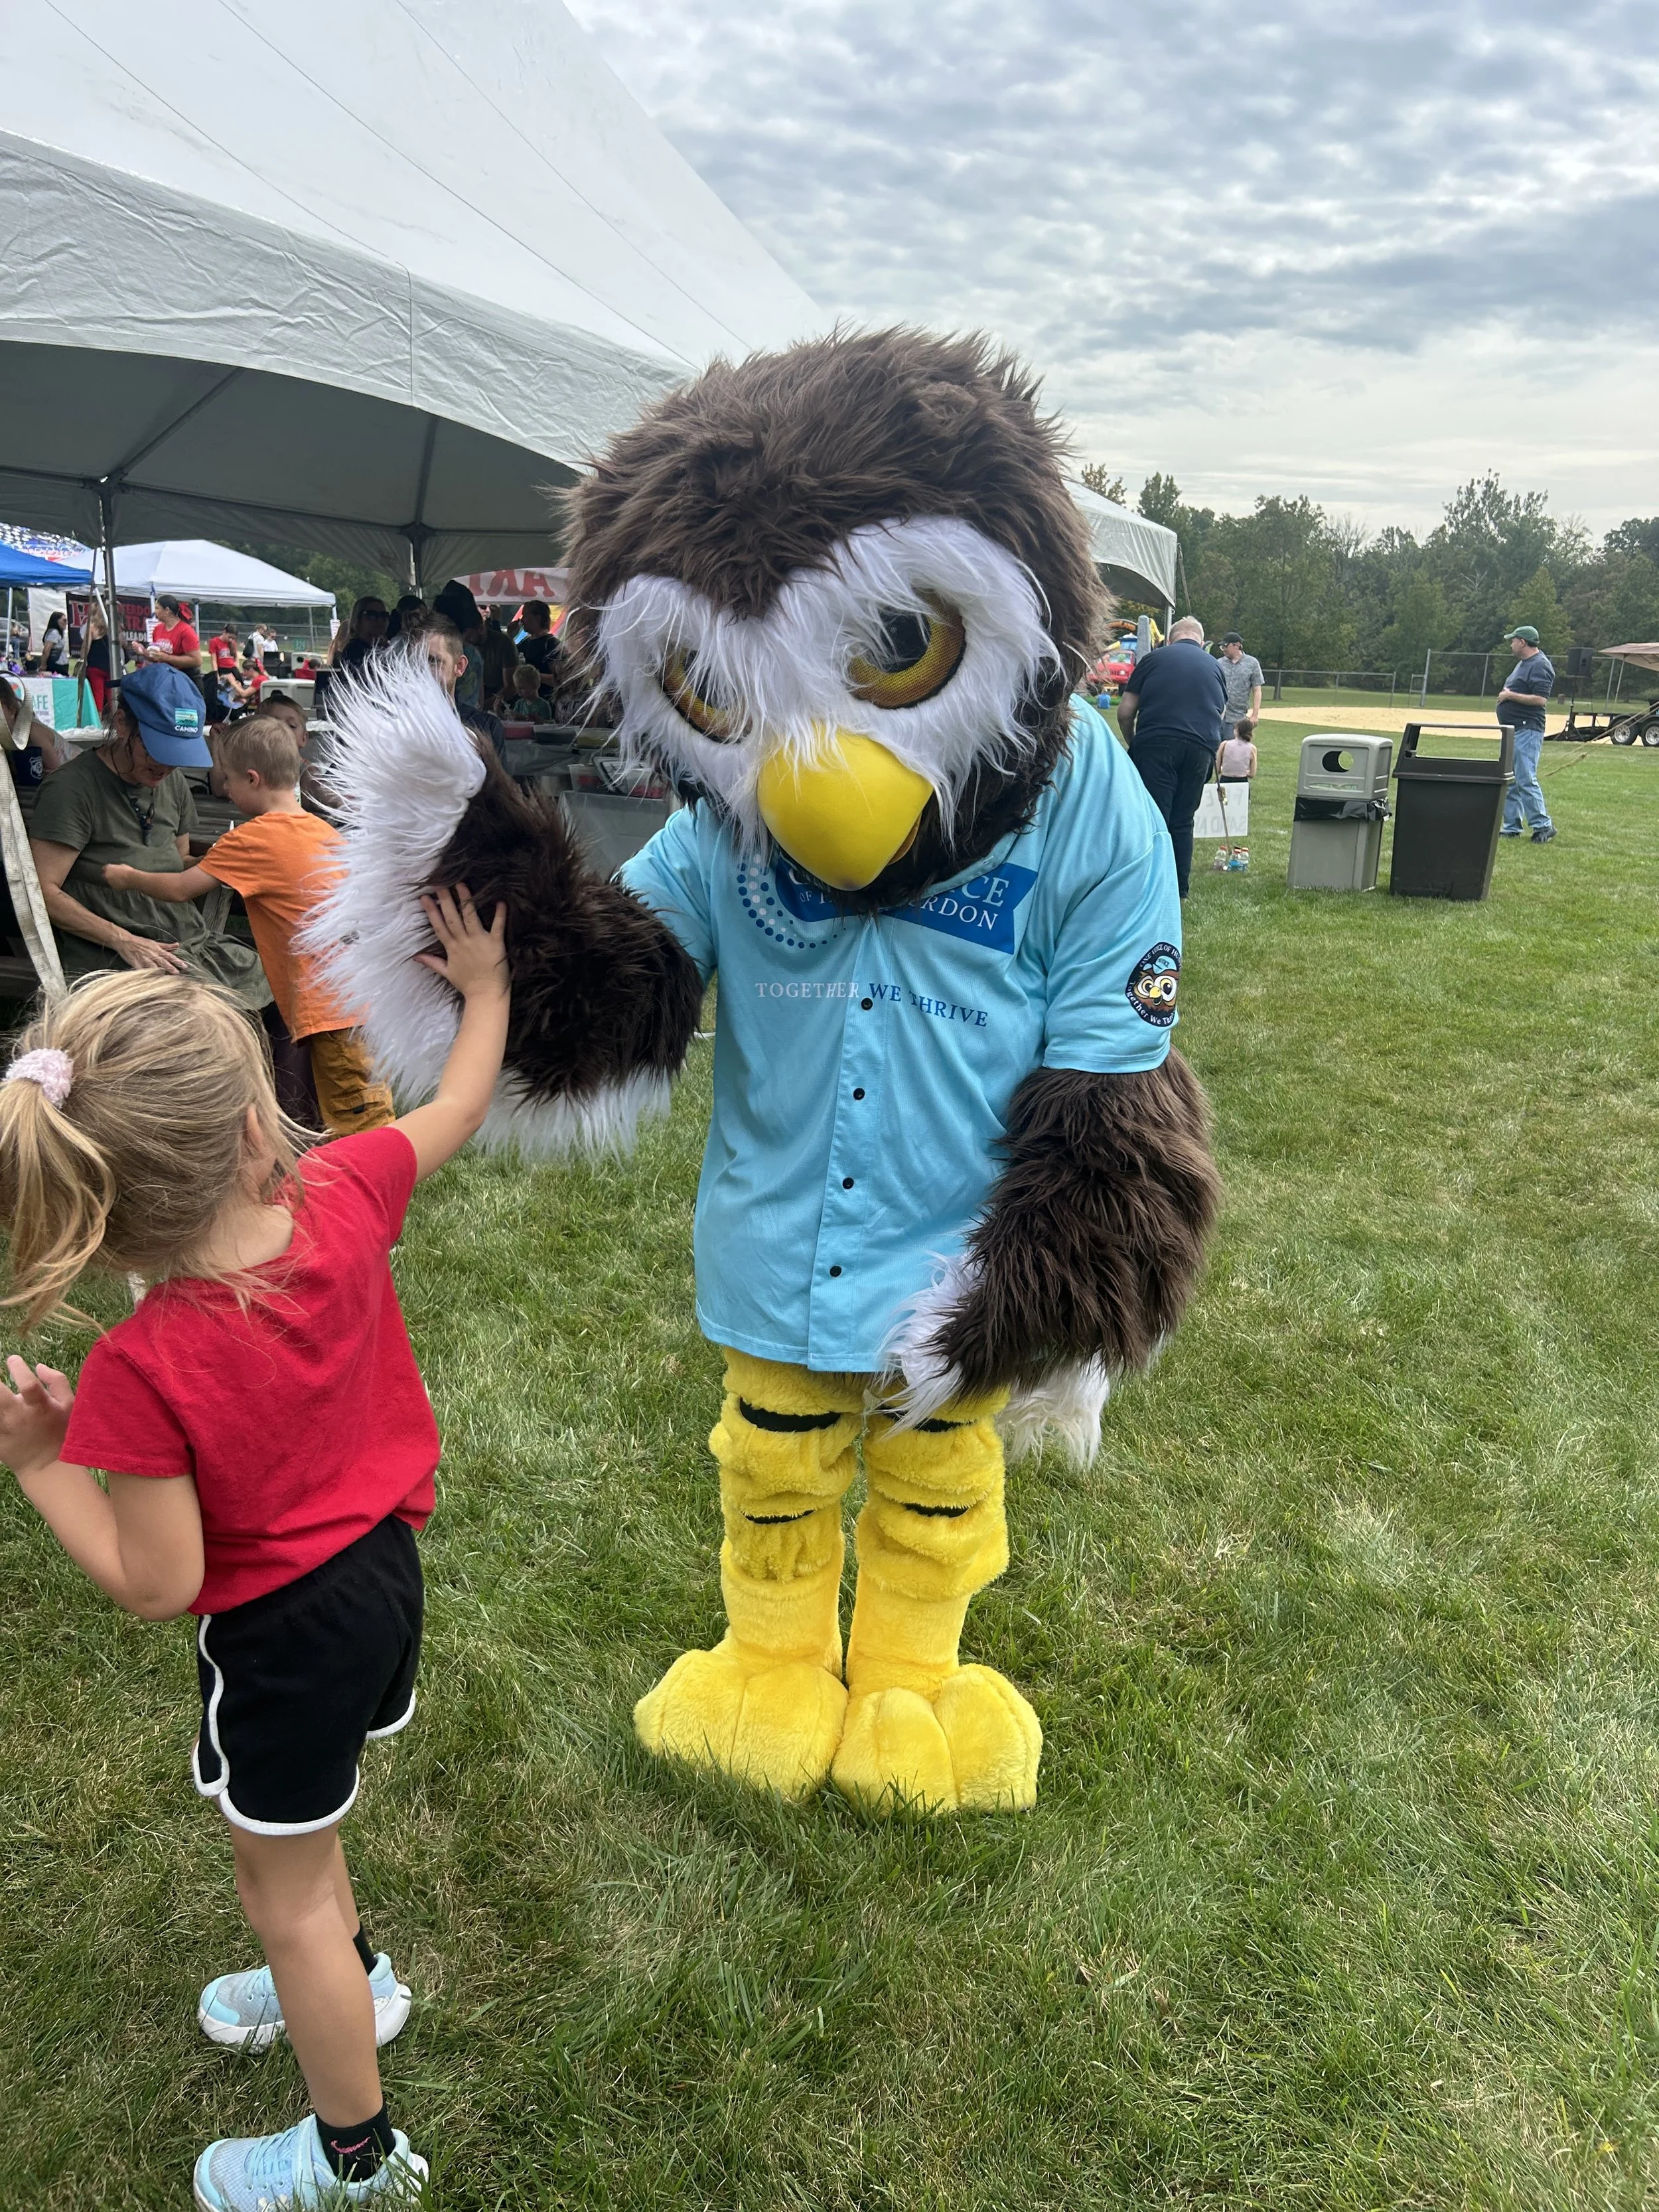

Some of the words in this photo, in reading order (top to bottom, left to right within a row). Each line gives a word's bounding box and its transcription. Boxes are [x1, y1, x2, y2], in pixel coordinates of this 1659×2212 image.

[32, 695, 48, 710] AFE
[175, 725, 198, 733] CAMINO
[799, 891, 812, 903] OF
[1163, 944, 1172, 953] OF
[755, 982, 860, 998] TOGETHER
[869, 983, 902, 1002] WE
[909, 990, 988, 1027] THRIVE
[1126, 980, 1149, 1018] Together
[1150, 1015, 1162, 1025] We
